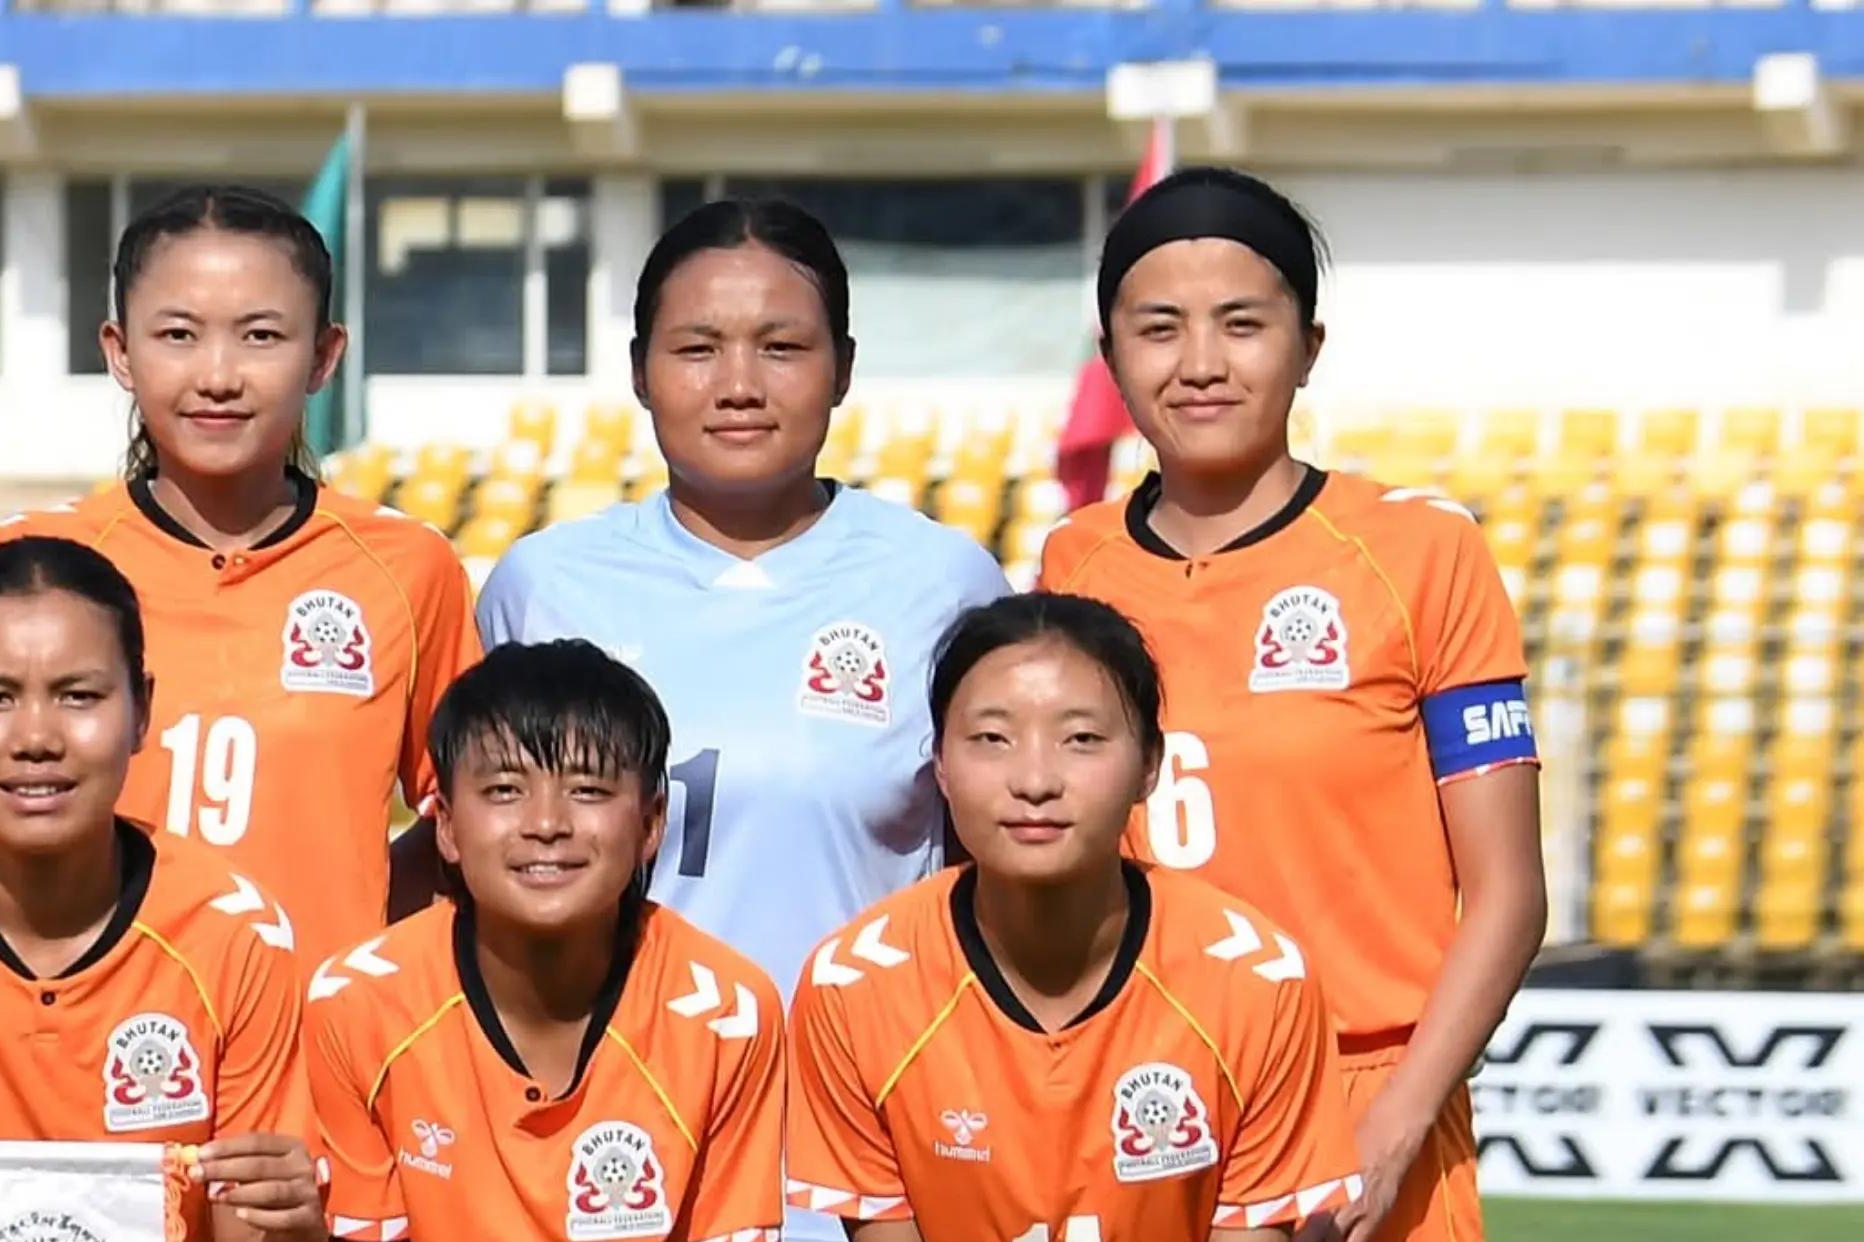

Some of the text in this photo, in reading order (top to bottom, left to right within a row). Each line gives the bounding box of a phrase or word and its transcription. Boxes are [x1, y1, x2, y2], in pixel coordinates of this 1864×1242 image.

[296, 596, 355, 619] BHUTAN
[1270, 593, 1332, 618] BHUTAN
[819, 628, 878, 651] BHUTAN
[1463, 700, 1532, 745] SAF
[161, 713, 257, 846] 19
[670, 748, 721, 878] 1
[1147, 731, 1217, 870] 6
[116, 1021, 181, 1049] BHUTAN
[1121, 1072, 1184, 1099] BHUTAN
[1472, 1086, 1848, 1115] CTOR VECTOR
[582, 1130, 646, 1156] BHUTAN
